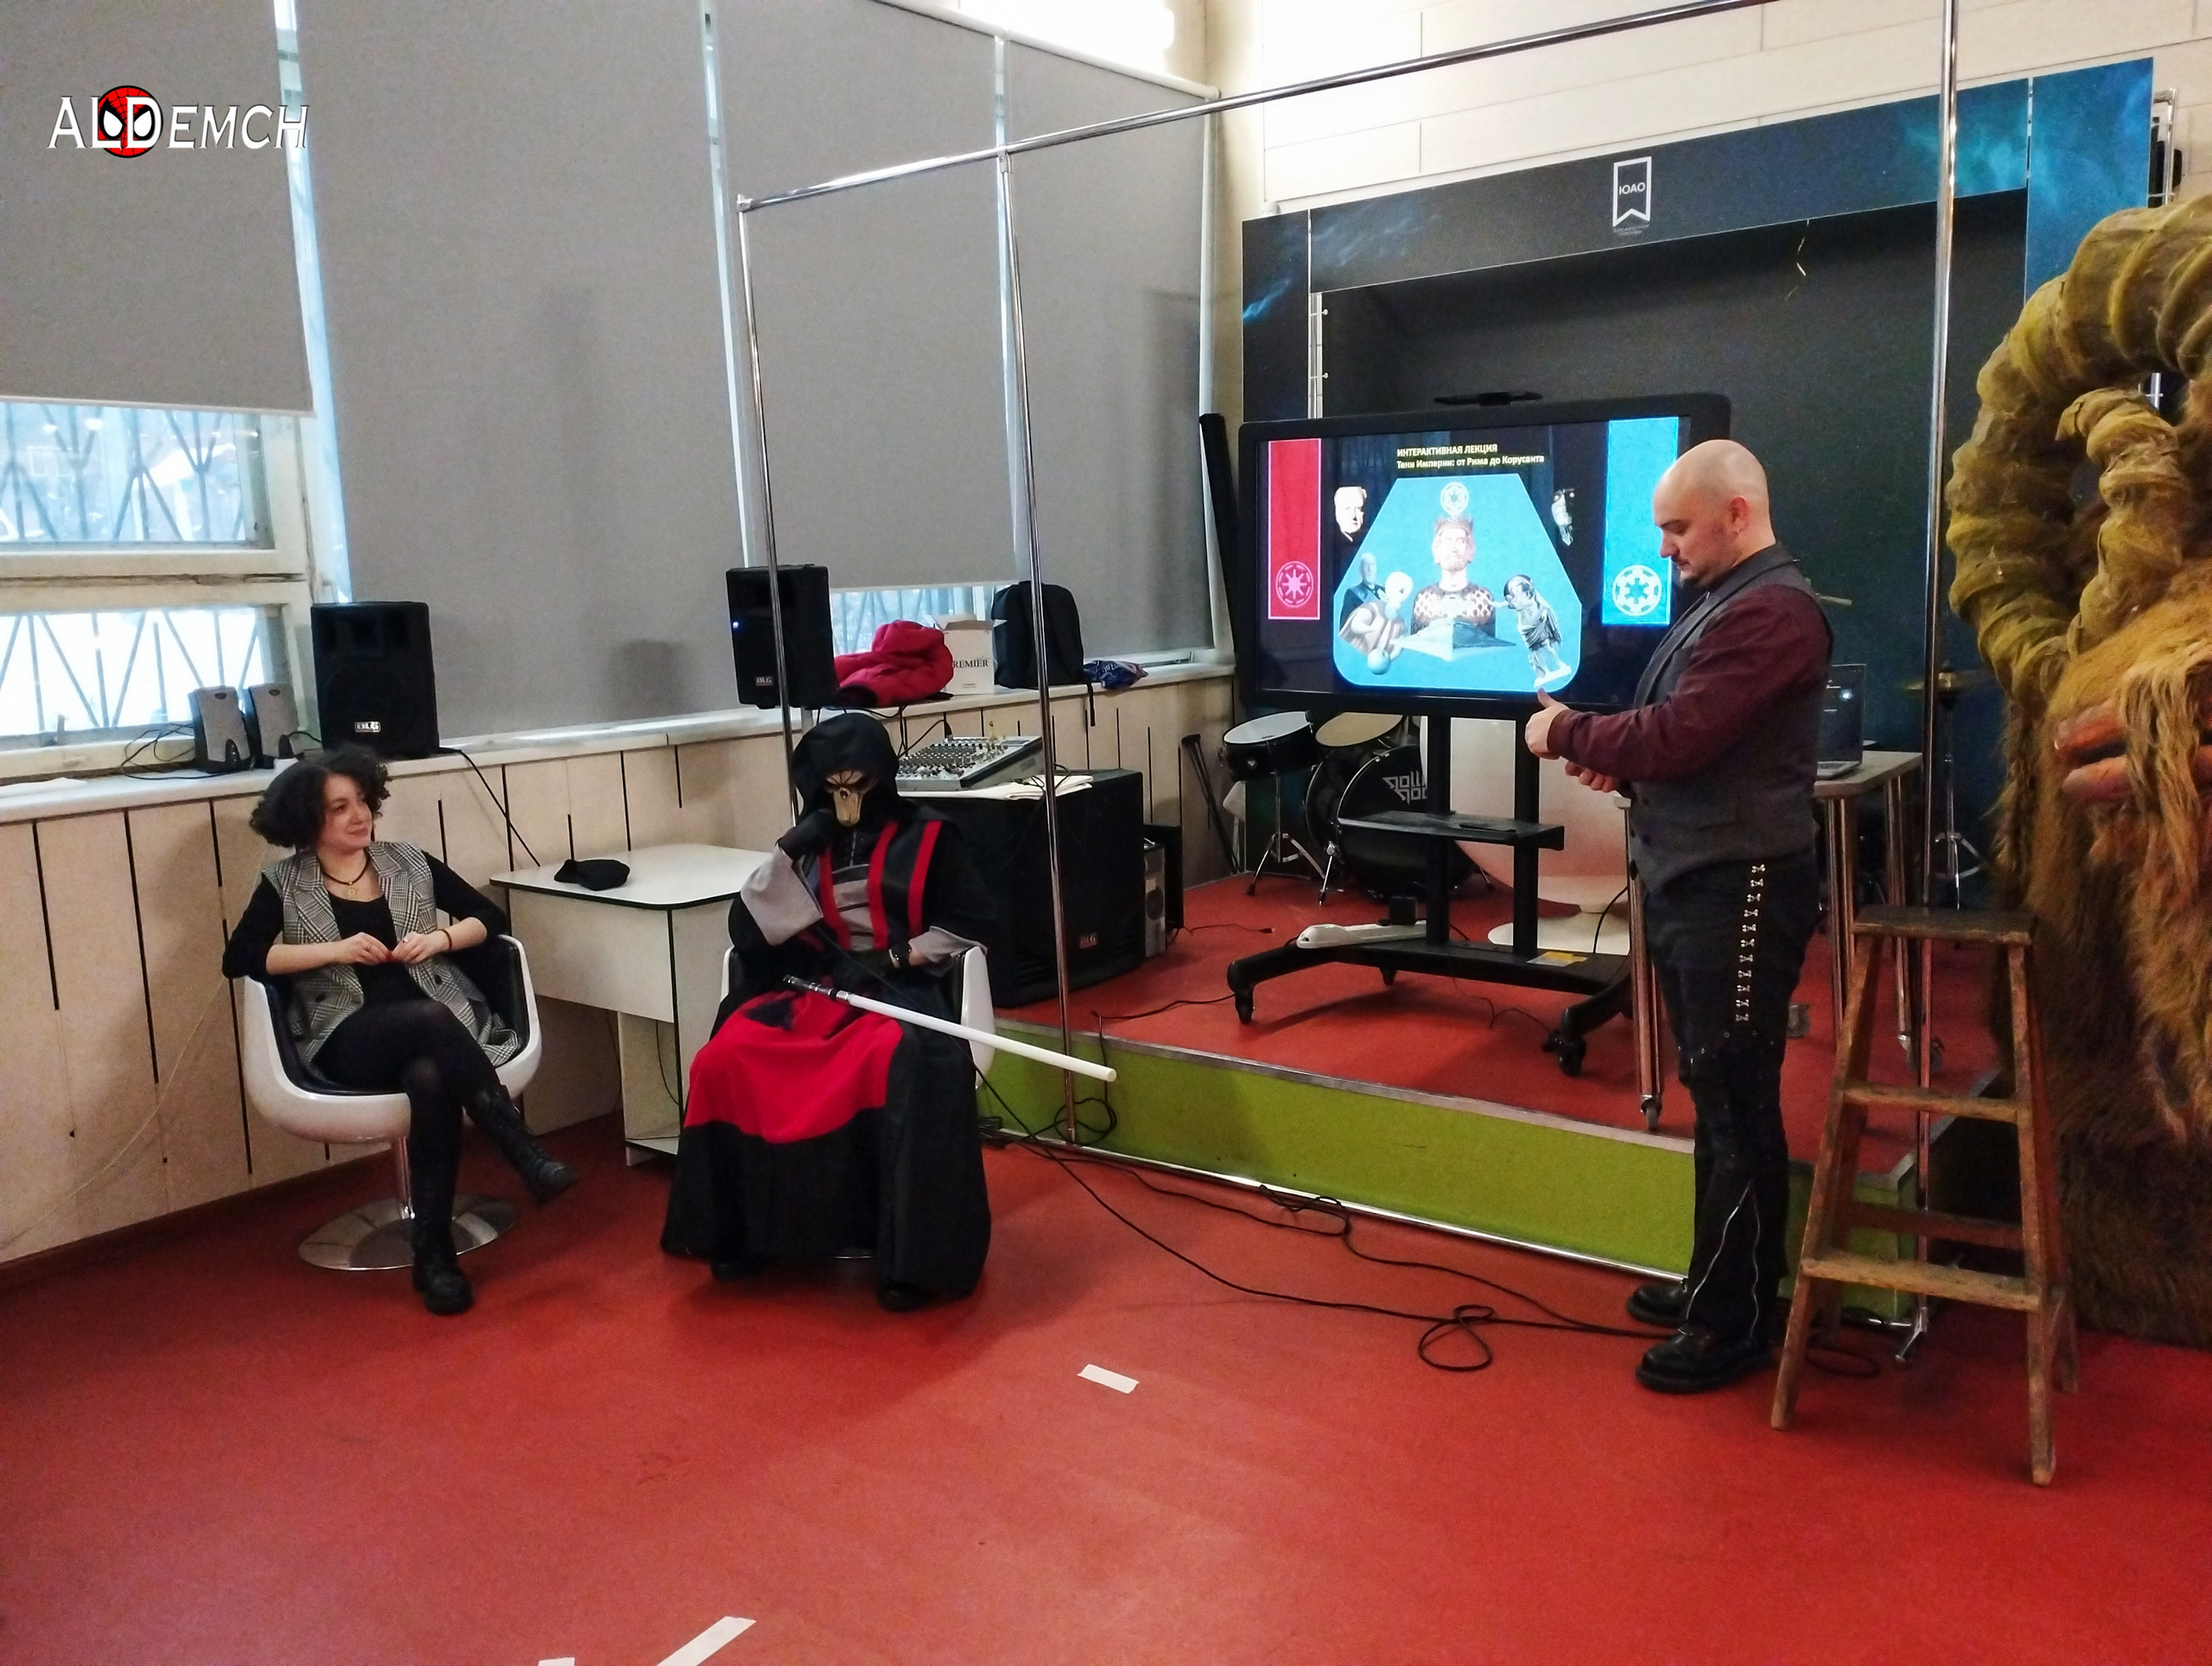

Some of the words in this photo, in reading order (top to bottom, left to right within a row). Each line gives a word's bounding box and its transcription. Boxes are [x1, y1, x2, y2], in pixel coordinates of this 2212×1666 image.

[1618, 182, 1646, 195] ЮАО
[1396, 445, 1463, 457] ИНТЕРАКТИВНАЯ
[1465, 443, 1498, 455] ЛЕКЦИЯ
[1396, 460, 1415, 469] Тени
[1416, 459, 1455, 468] Империи:
[1467, 457, 1489, 467] Рима
[1490, 457, 1501, 467] до
[1502, 455, 1545, 466] Корусанта
[953, 659, 989, 669] REMIER
